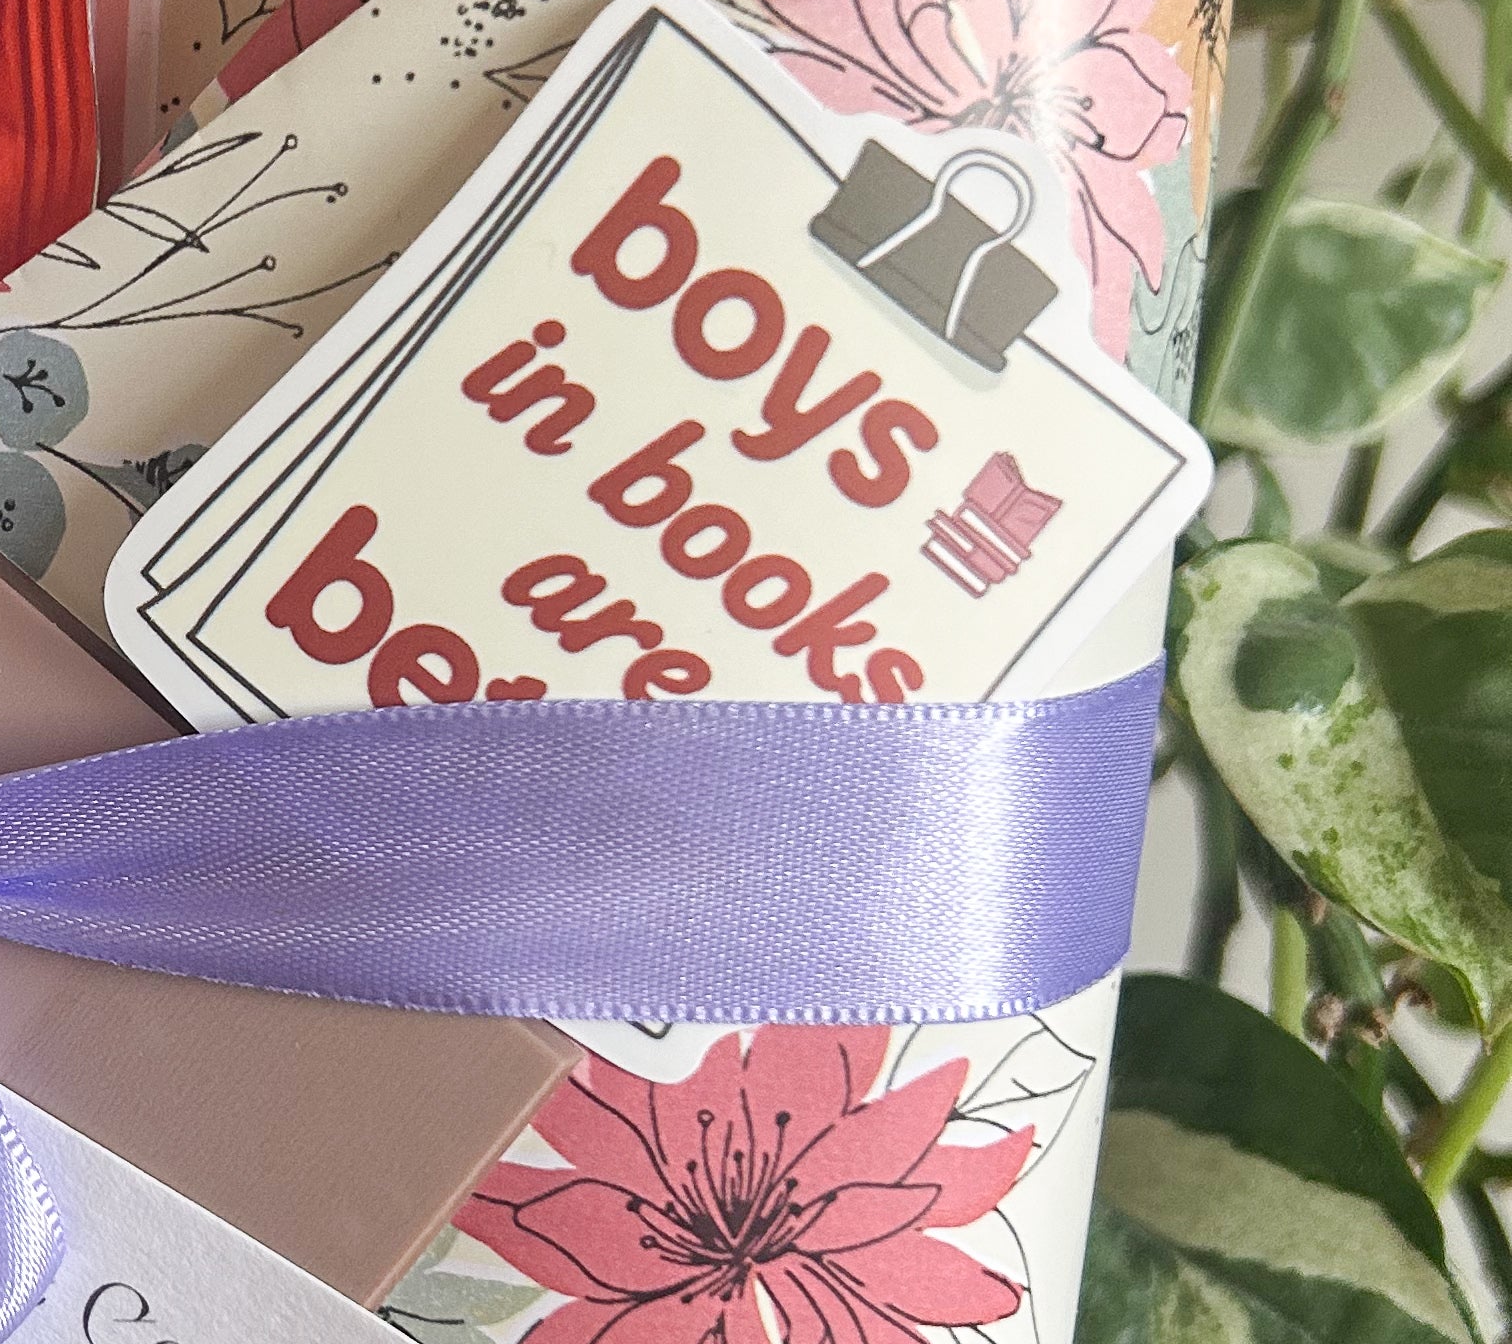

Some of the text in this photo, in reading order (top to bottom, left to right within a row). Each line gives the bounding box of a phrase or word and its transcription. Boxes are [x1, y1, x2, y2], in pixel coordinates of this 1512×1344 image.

[461, 320, 598, 456] in
[571, 155, 941, 509] boys
[265, 504, 548, 709] be
[501, 554, 713, 704] are
[588, 420, 925, 706] books
